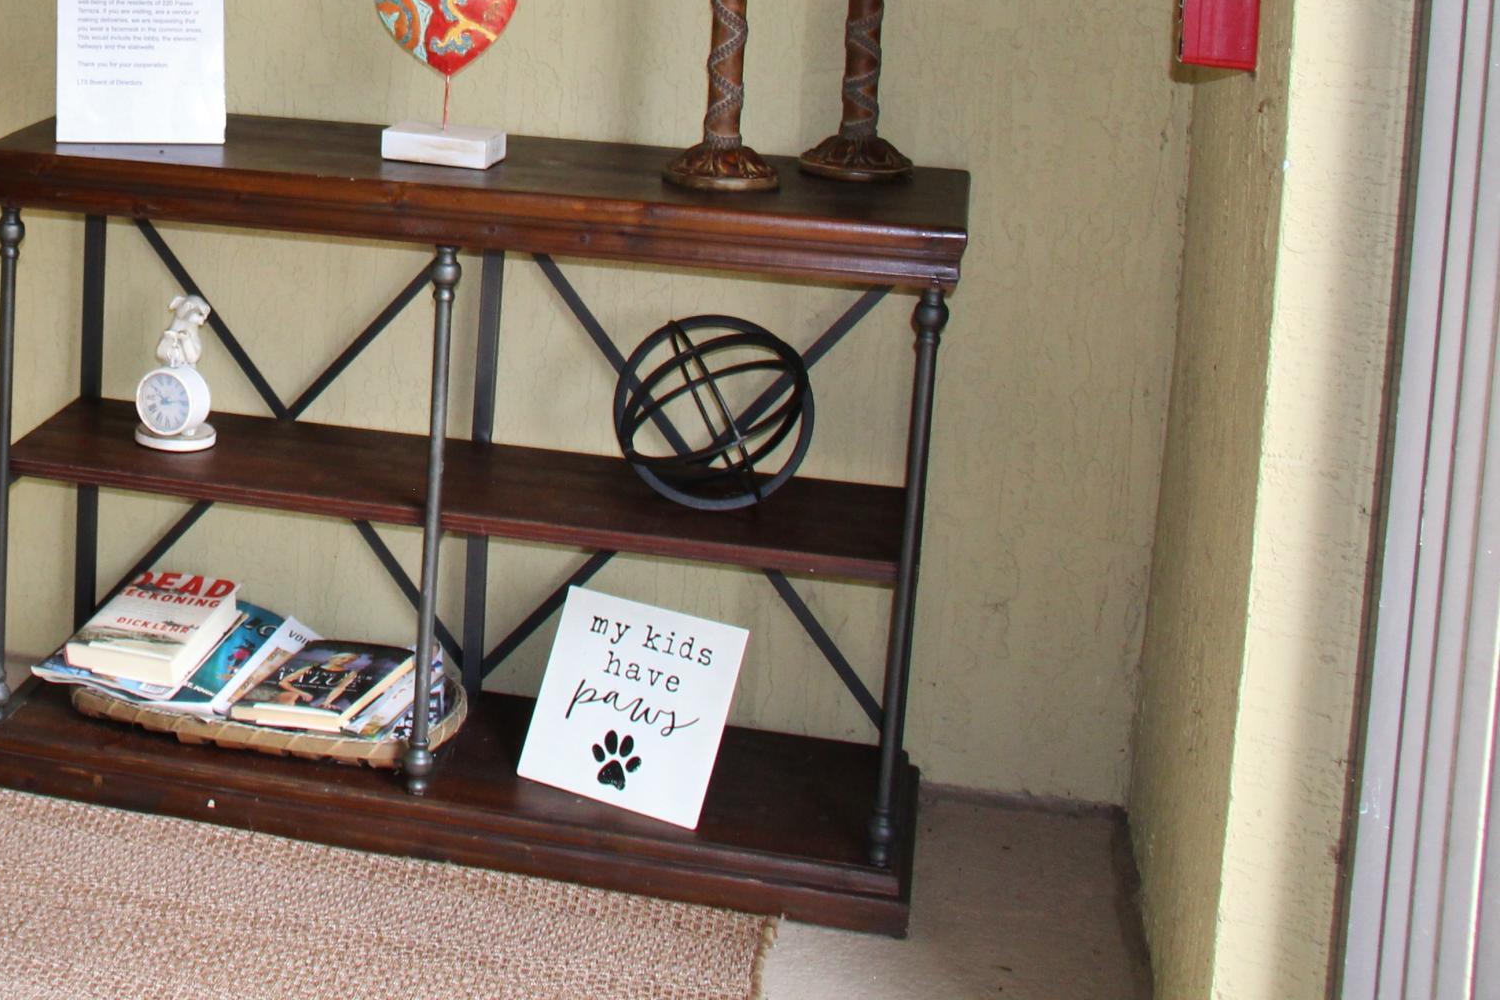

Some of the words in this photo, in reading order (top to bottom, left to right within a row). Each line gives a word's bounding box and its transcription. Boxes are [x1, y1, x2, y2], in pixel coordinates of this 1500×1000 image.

[123, 587, 220, 608] ECKONING
[116, 616, 149, 628] DICK
[590, 615, 631, 644] my
[642, 625, 713, 666] kids
[603, 651, 680, 692] have
[565, 679, 700, 737] paws
